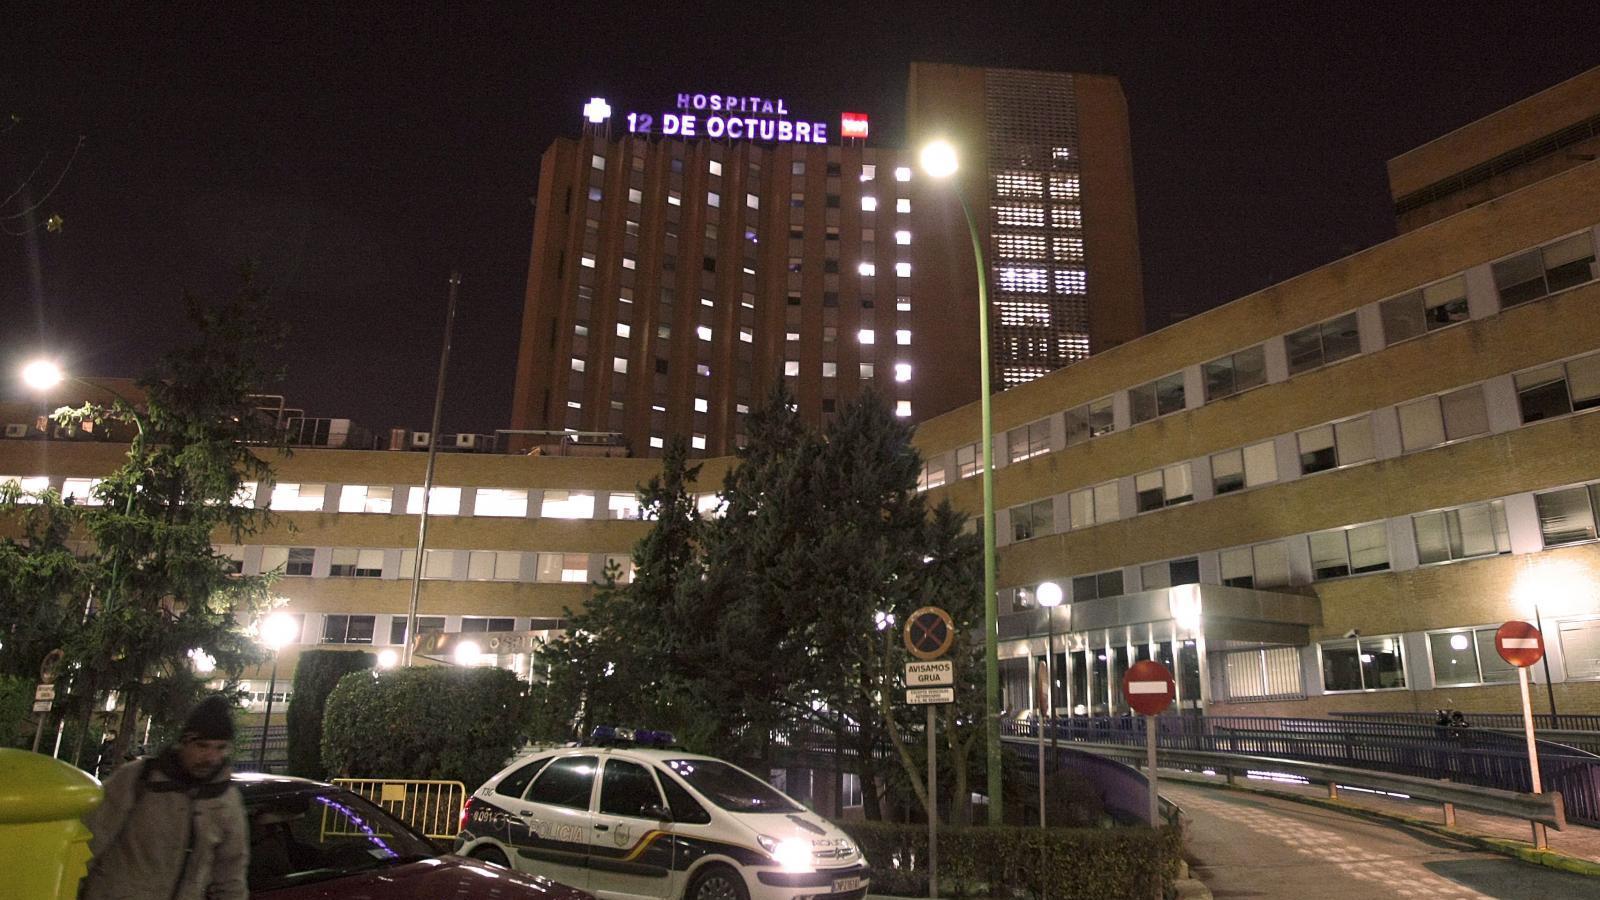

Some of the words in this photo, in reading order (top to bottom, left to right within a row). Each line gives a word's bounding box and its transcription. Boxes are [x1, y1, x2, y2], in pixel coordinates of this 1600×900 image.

[677, 93, 788, 115] HOSPITAL
[627, 112, 653, 133] 12
[663, 114, 696, 136] DE
[706, 117, 828, 143] OCTUBRE
[908, 663, 950, 673] AVISAMOS
[918, 674, 941, 682] GRUA
[528, 819, 584, 843] POLICIA
